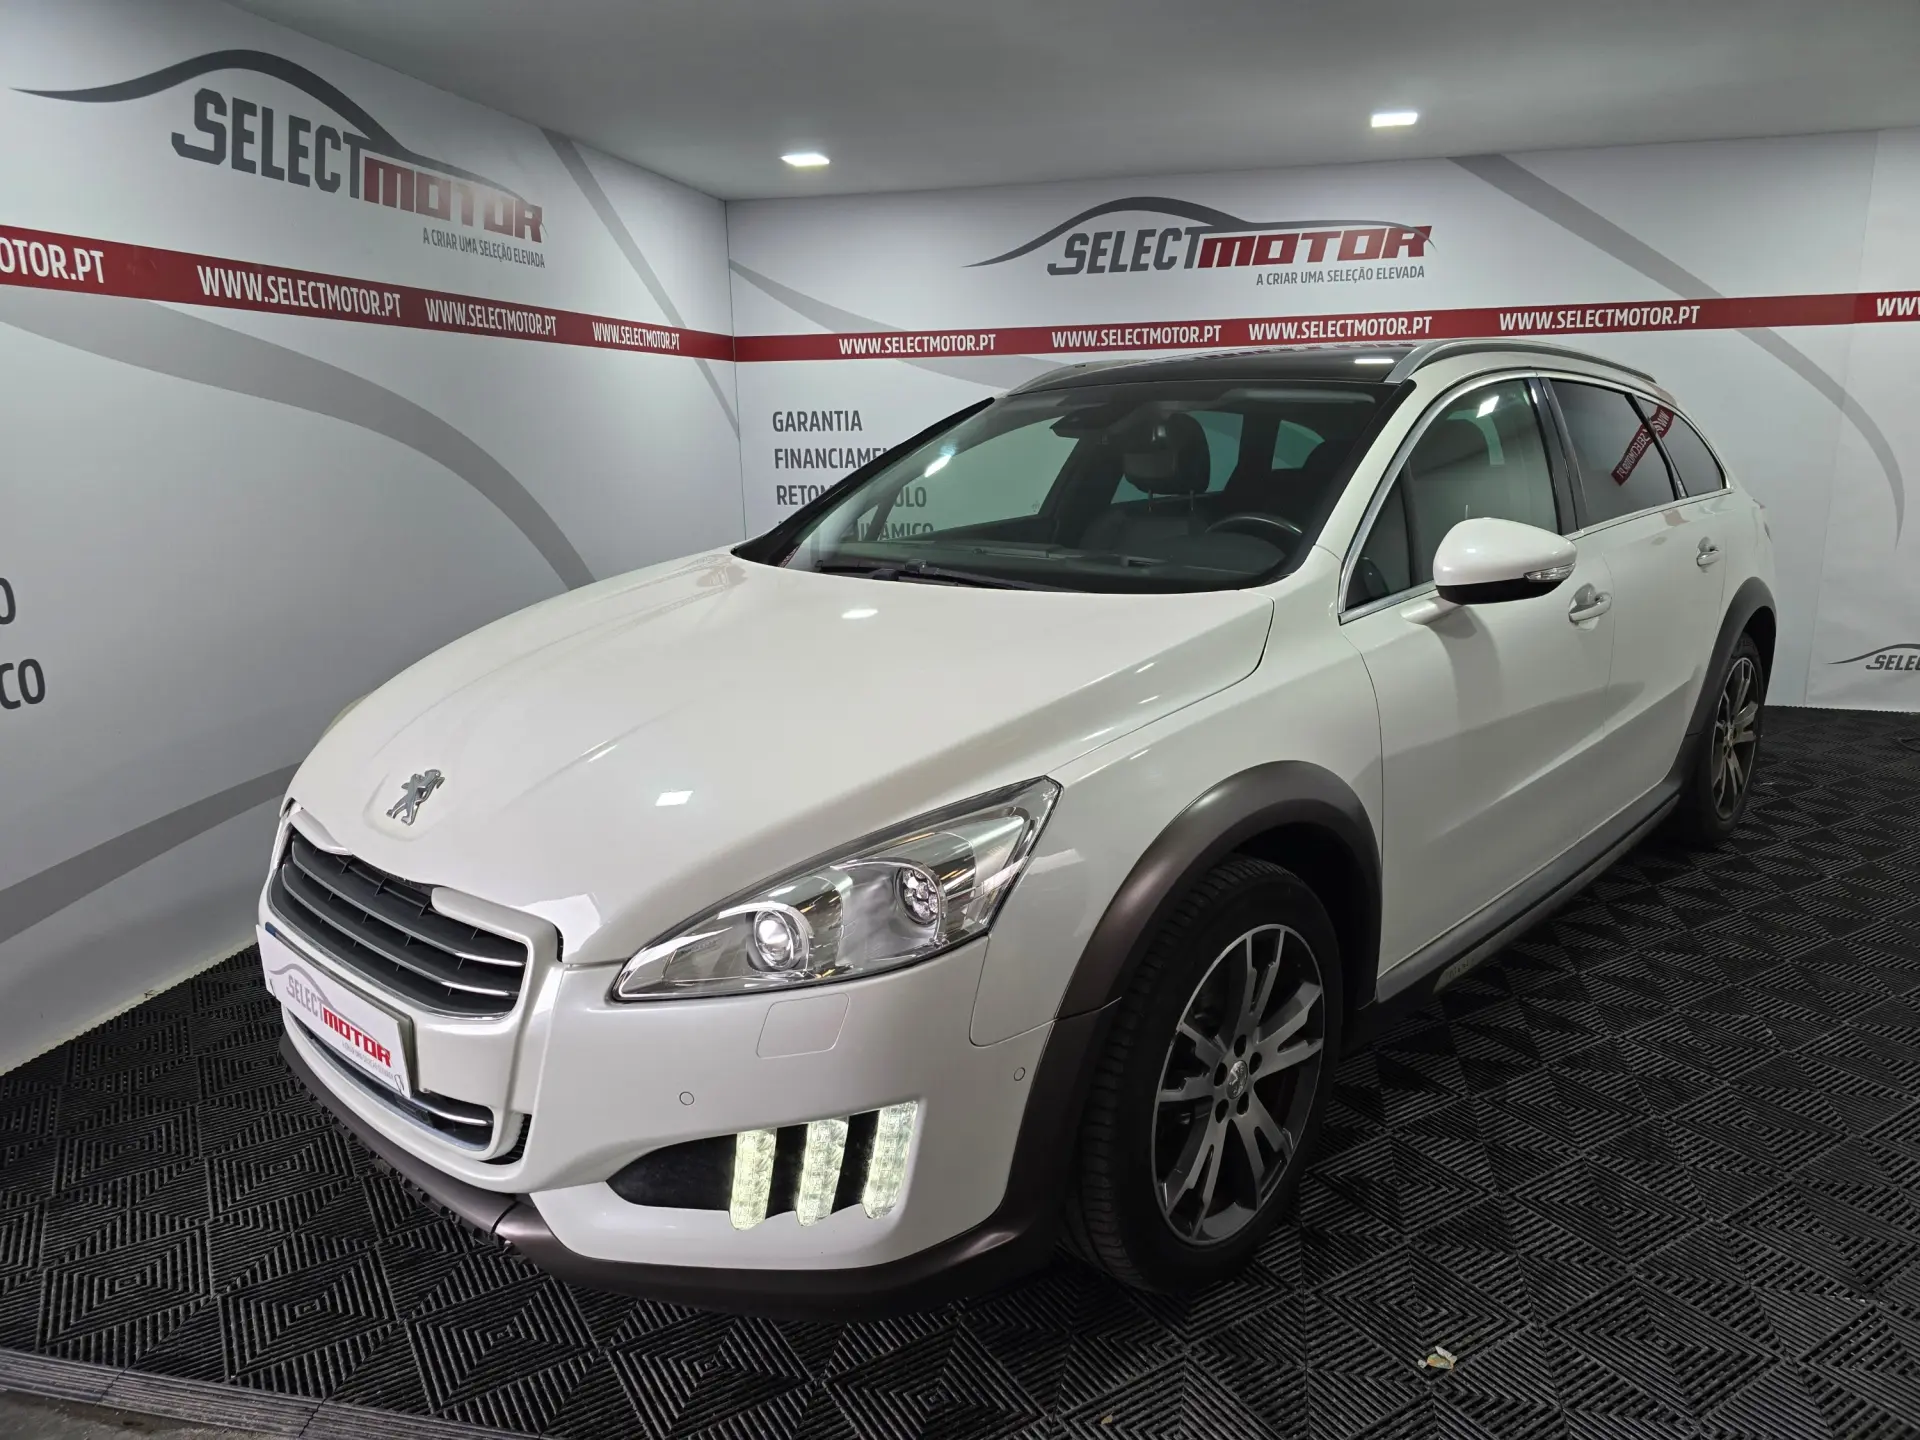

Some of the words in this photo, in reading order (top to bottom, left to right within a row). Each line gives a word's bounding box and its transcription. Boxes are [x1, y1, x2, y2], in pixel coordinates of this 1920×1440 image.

[423, 227, 430, 244] A
[431, 230, 458, 251] CRIAR
[459, 234, 479, 256] UMA
[480, 239, 512, 262] SELEÇÃO
[514, 247, 546, 269] ELEVADA
[1256, 273, 1264, 286] A
[1266, 271, 1298, 285] CRIAR
[1300, 270, 1324, 284] UMA
[1327, 266, 1374, 283] SELEÇÃO
[1376, 265, 1425, 280] ELEVADA
[197, 265, 401, 318] WWW.SELECTMOTOR.PT
[425, 297, 557, 337] WWW.SELECTMOTOR.PT
[592, 321, 680, 351] WWW.SELECTMOTOR.PT
[839, 333, 996, 355] WWW.SELECTMOTOR.PT
[1052, 324, 1222, 349] WWW.SELECTMOTOR.PT
[1248, 315, 1433, 341] WWW.SELECTMOTOR.PT
[1499, 305, 1700, 332] WWW.SELECTMOTOR.PT
[1876, 296, 1920, 317] WW
[772, 410, 863, 432] GARANTIA
[776, 483, 831, 505] RETO
